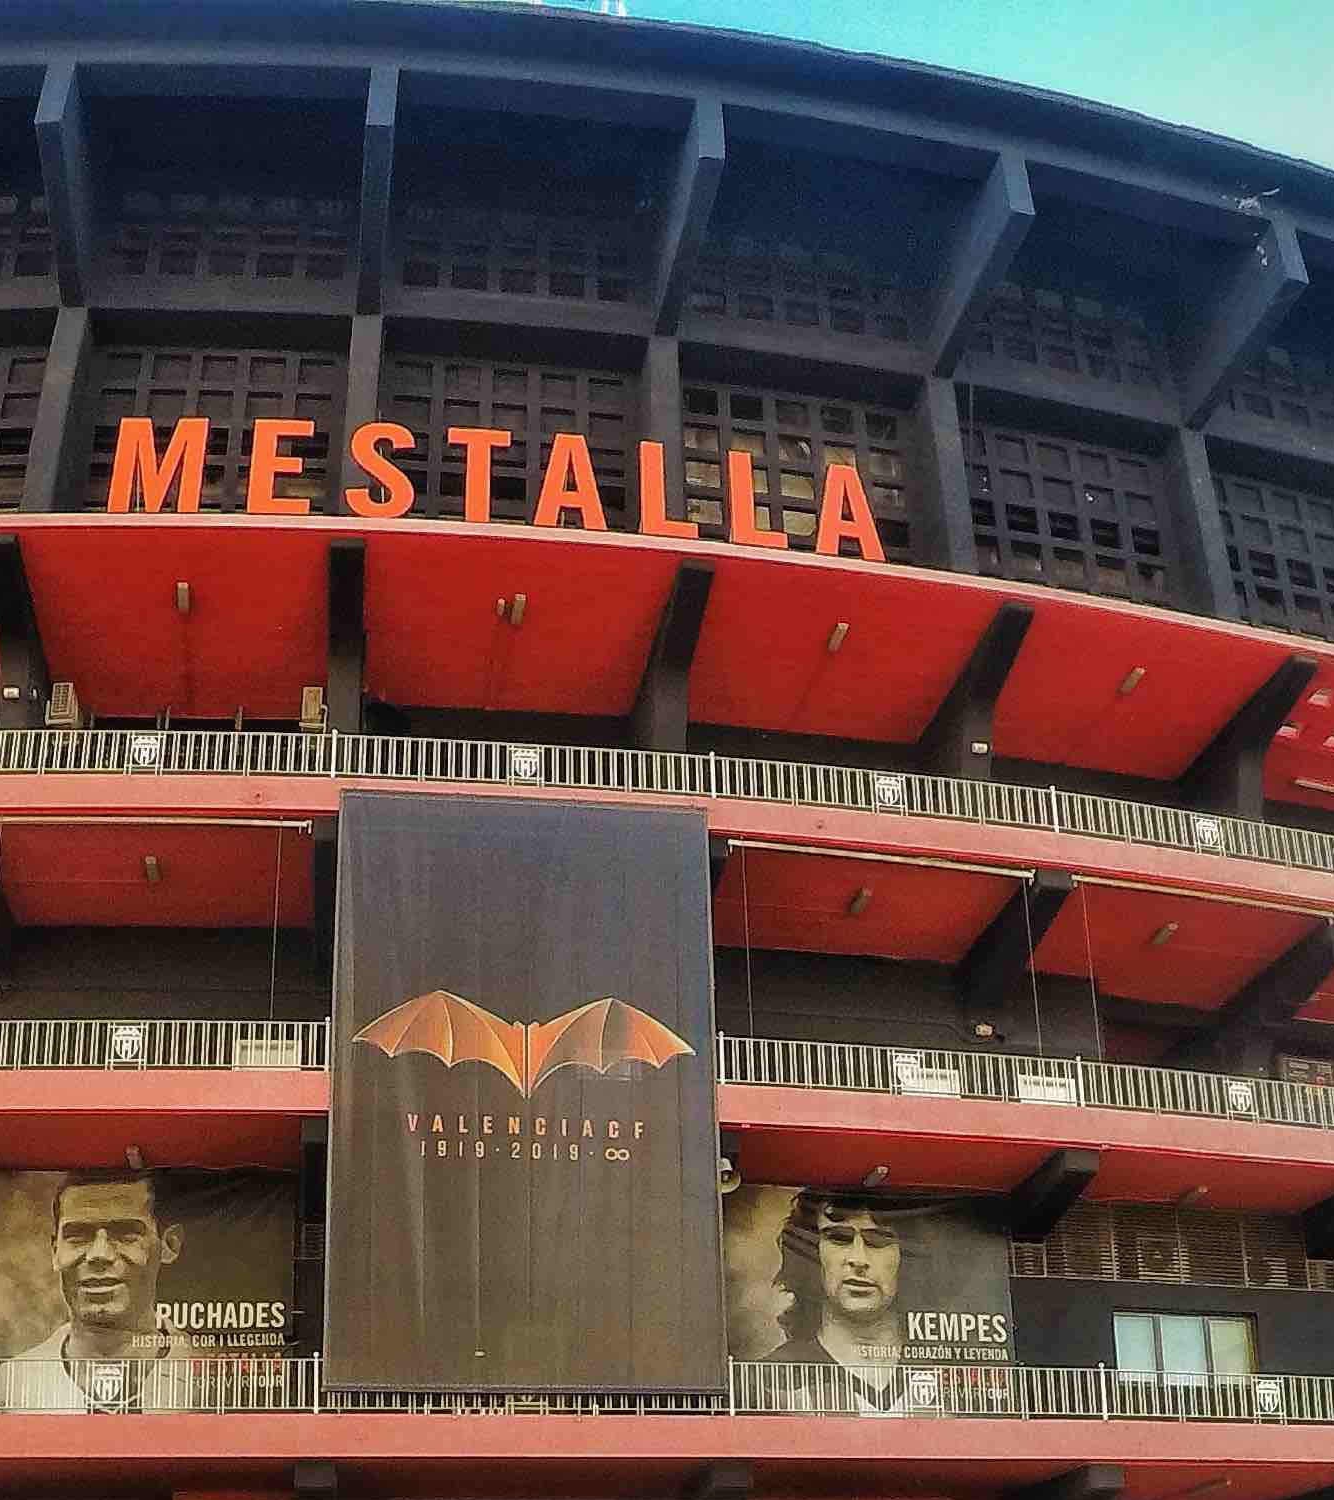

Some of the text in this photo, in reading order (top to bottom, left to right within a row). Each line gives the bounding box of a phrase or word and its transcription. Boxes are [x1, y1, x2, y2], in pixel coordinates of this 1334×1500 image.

[106, 417, 886, 563] MESTALLA
[155, 1301, 286, 1330] RUCHADES
[907, 1312, 1009, 1343] KEMPES
[192, 1333, 216, 1348] COR
[227, 1331, 286, 1348] LLEGENDA
[904, 1343, 952, 1360] CORAZÓN
[955, 1346, 962, 1361] Y
[964, 1346, 1009, 1361] LEYENDA
